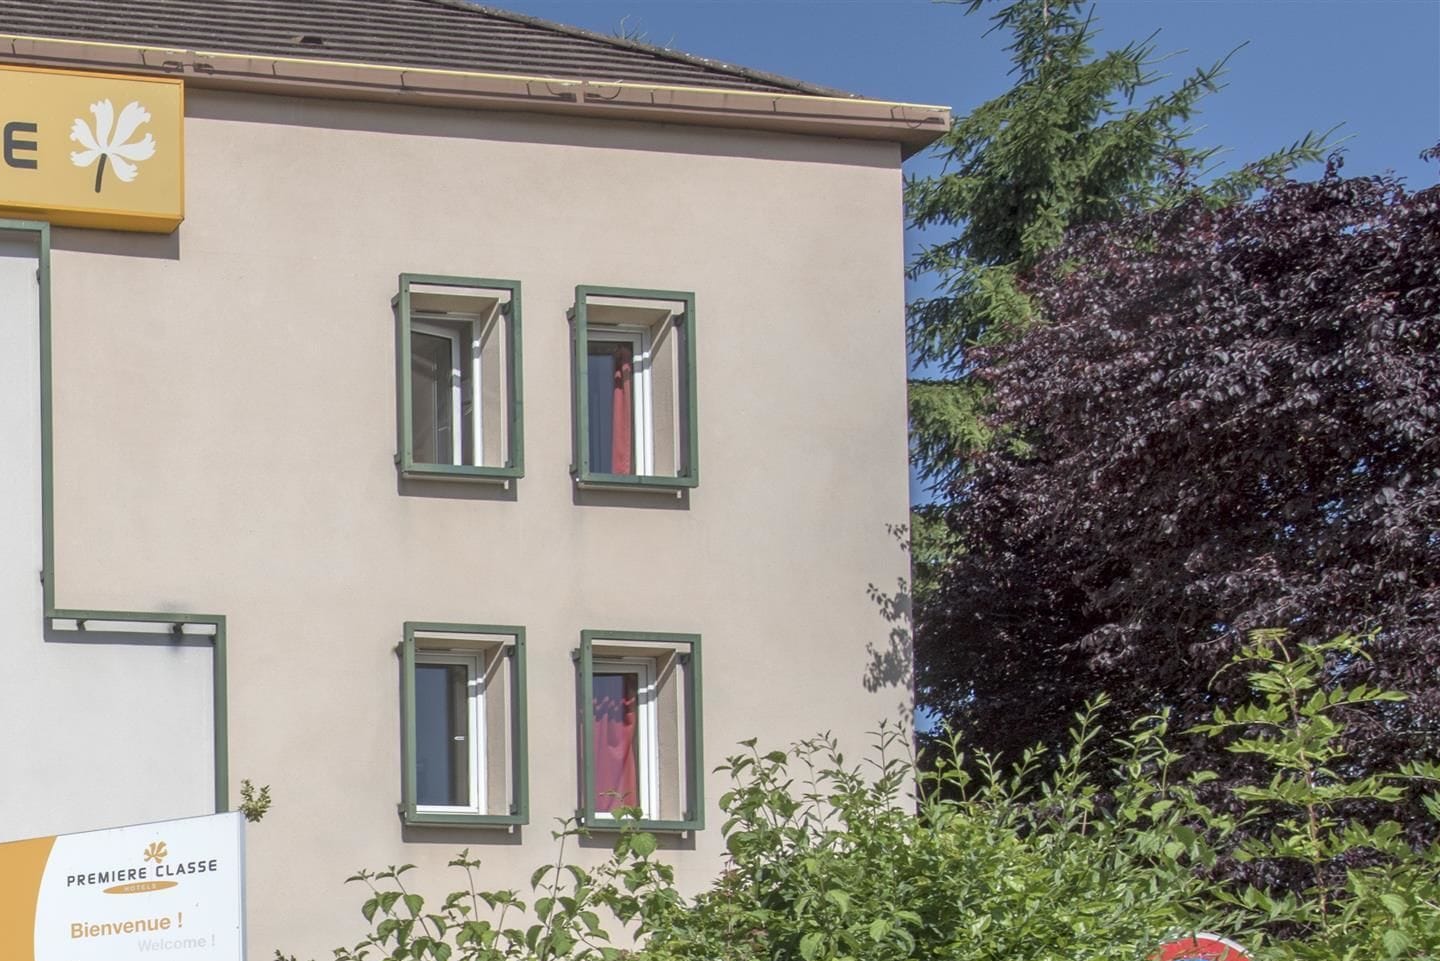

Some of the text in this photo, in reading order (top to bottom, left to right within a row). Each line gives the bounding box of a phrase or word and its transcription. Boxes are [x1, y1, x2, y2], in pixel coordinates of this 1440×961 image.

[67, 859, 218, 887] PREMIERE CLASSE
[123, 883, 157, 892] HOTELS
[70, 916, 171, 939] Bienvenue
[138, 936, 207, 952] Welcome
